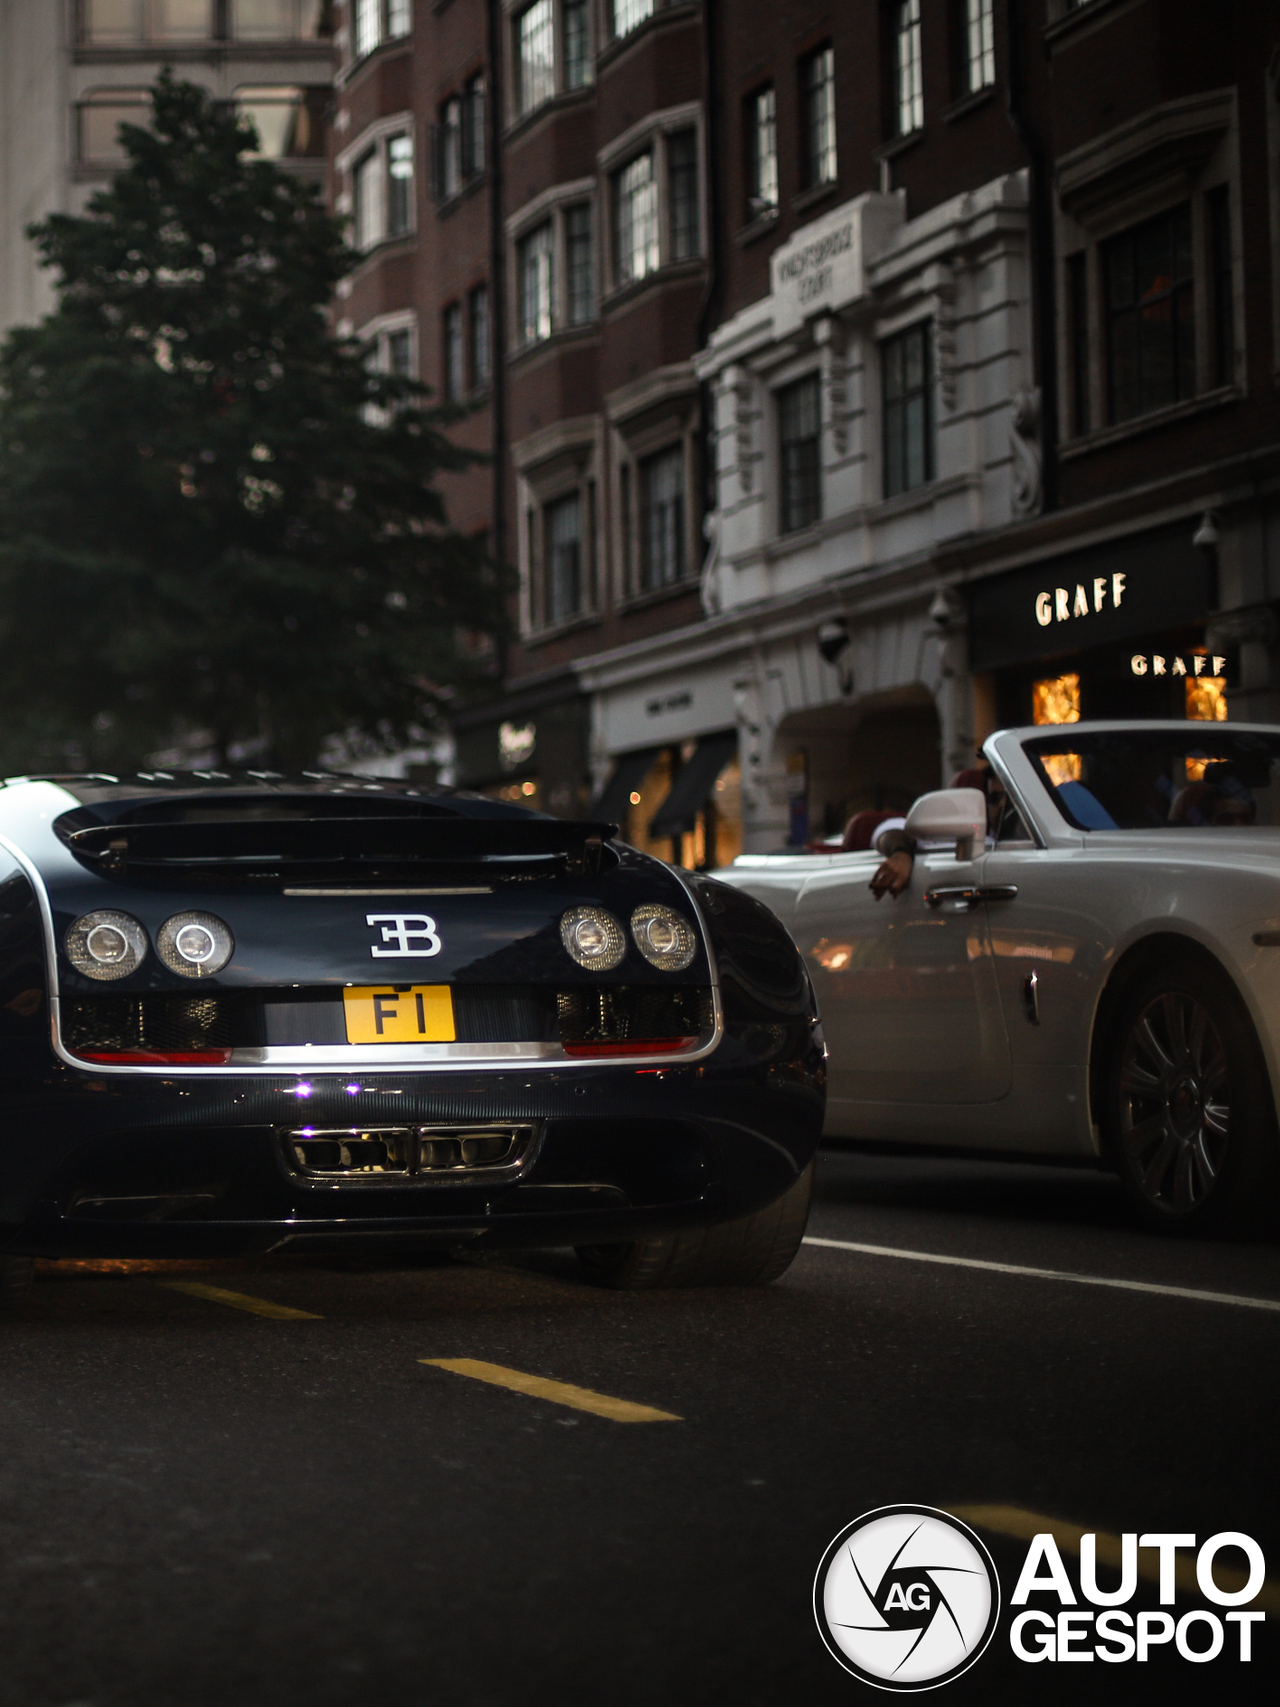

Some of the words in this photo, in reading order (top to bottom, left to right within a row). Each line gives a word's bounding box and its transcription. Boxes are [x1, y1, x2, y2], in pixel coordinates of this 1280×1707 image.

[1035, 572, 1127, 627] GRAFF
[1131, 654, 1227, 676] GRAFF
[372, 992, 427, 1035] F1
